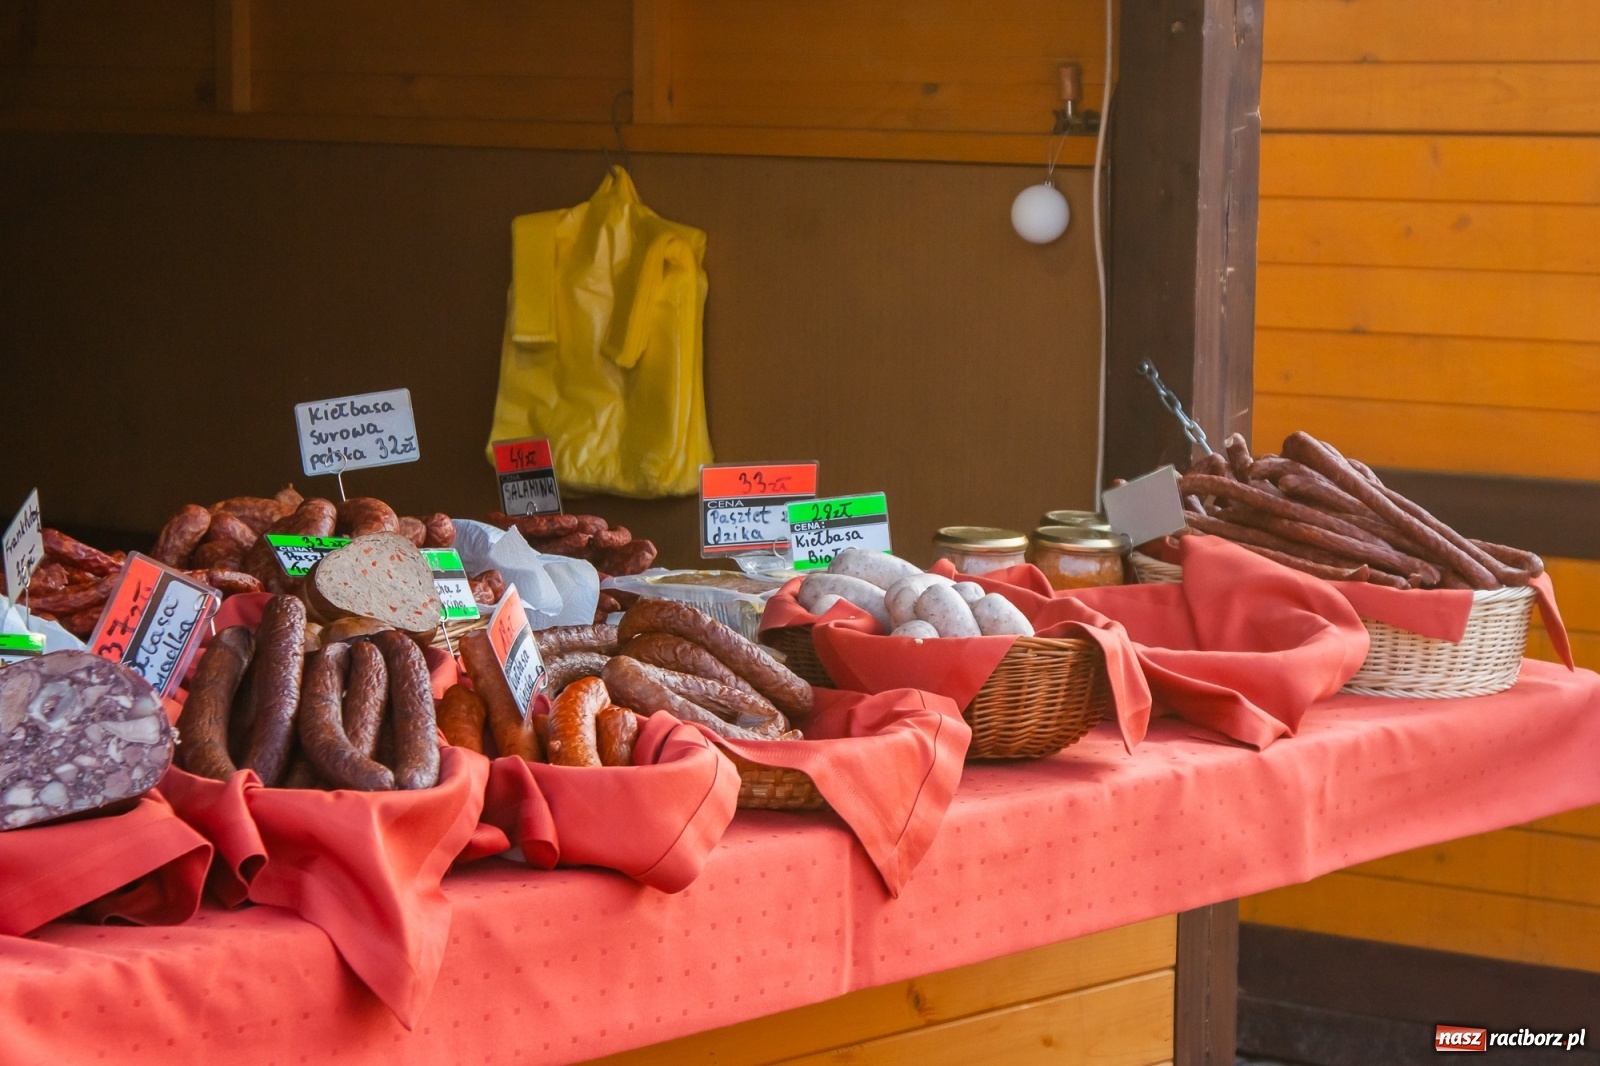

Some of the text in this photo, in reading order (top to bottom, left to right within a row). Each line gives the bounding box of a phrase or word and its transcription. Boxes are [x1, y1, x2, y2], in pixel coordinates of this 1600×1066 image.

[308, 400, 395, 425] Kiełbasa
[707, 500, 745, 510] CENA
[712, 526, 764, 545] dzika
[794, 529, 864, 548] Kiełbasa
